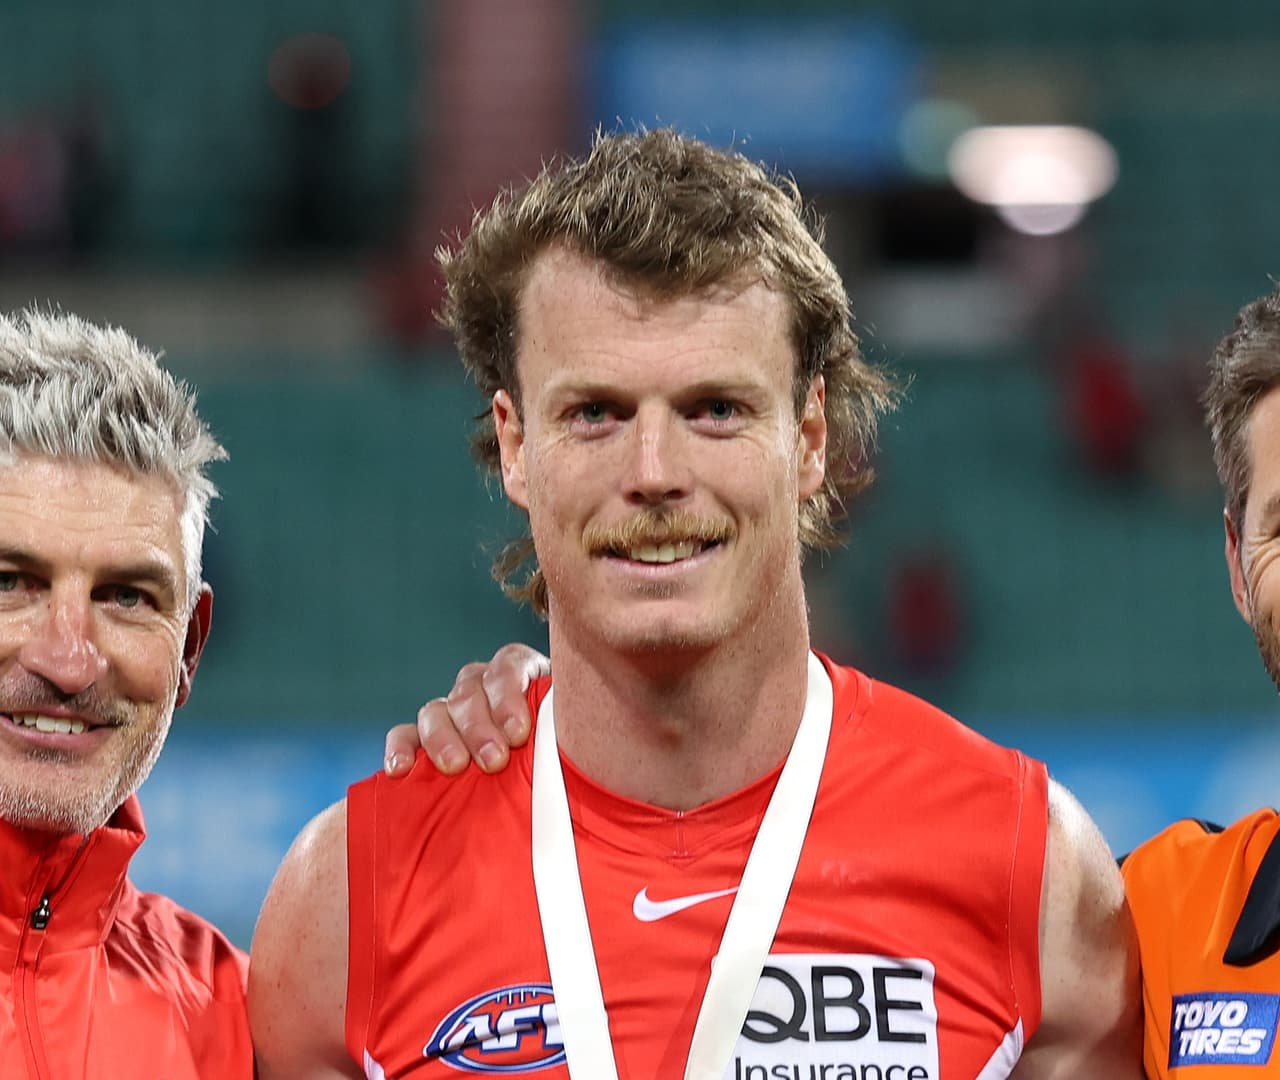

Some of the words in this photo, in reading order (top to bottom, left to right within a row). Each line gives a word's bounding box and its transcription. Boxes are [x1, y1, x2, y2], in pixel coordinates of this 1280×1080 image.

[741, 966, 927, 1044] QBE
[1174, 1000, 1248, 1031] TOYO
[1179, 1028, 1267, 1056] TIRES
